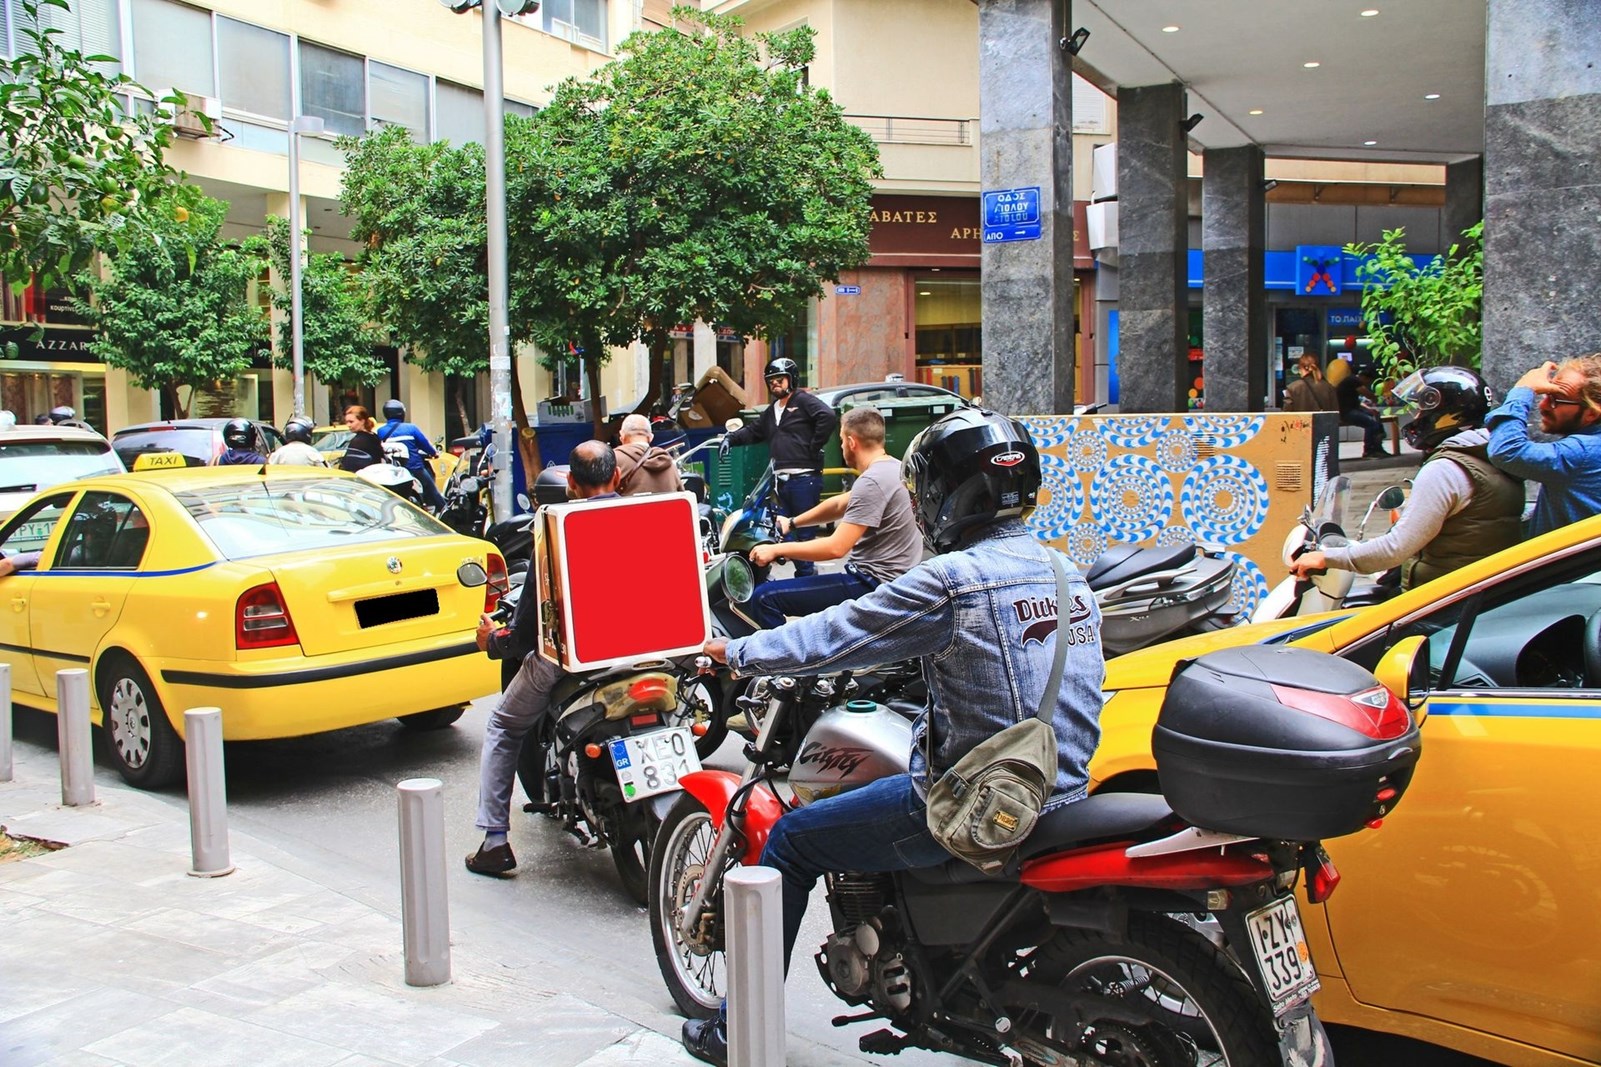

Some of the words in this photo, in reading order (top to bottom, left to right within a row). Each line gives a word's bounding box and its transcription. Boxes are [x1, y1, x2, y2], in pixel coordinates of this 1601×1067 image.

[998, 192, 1026, 202] ΟΔΟΣ
[870, 211, 937, 223] ΑΒΑΤΕΣ
[951, 227, 981, 239] ΑΡΗ
[986, 231, 1004, 241] ΑΠΟ
[36, 340, 88, 351] AZZAR
[150, 456, 177, 466] TAXI
[1013, 594, 1088, 622] Dicks
[616, 757, 629, 767] GR
[1264, 946, 1303, 990] 339
